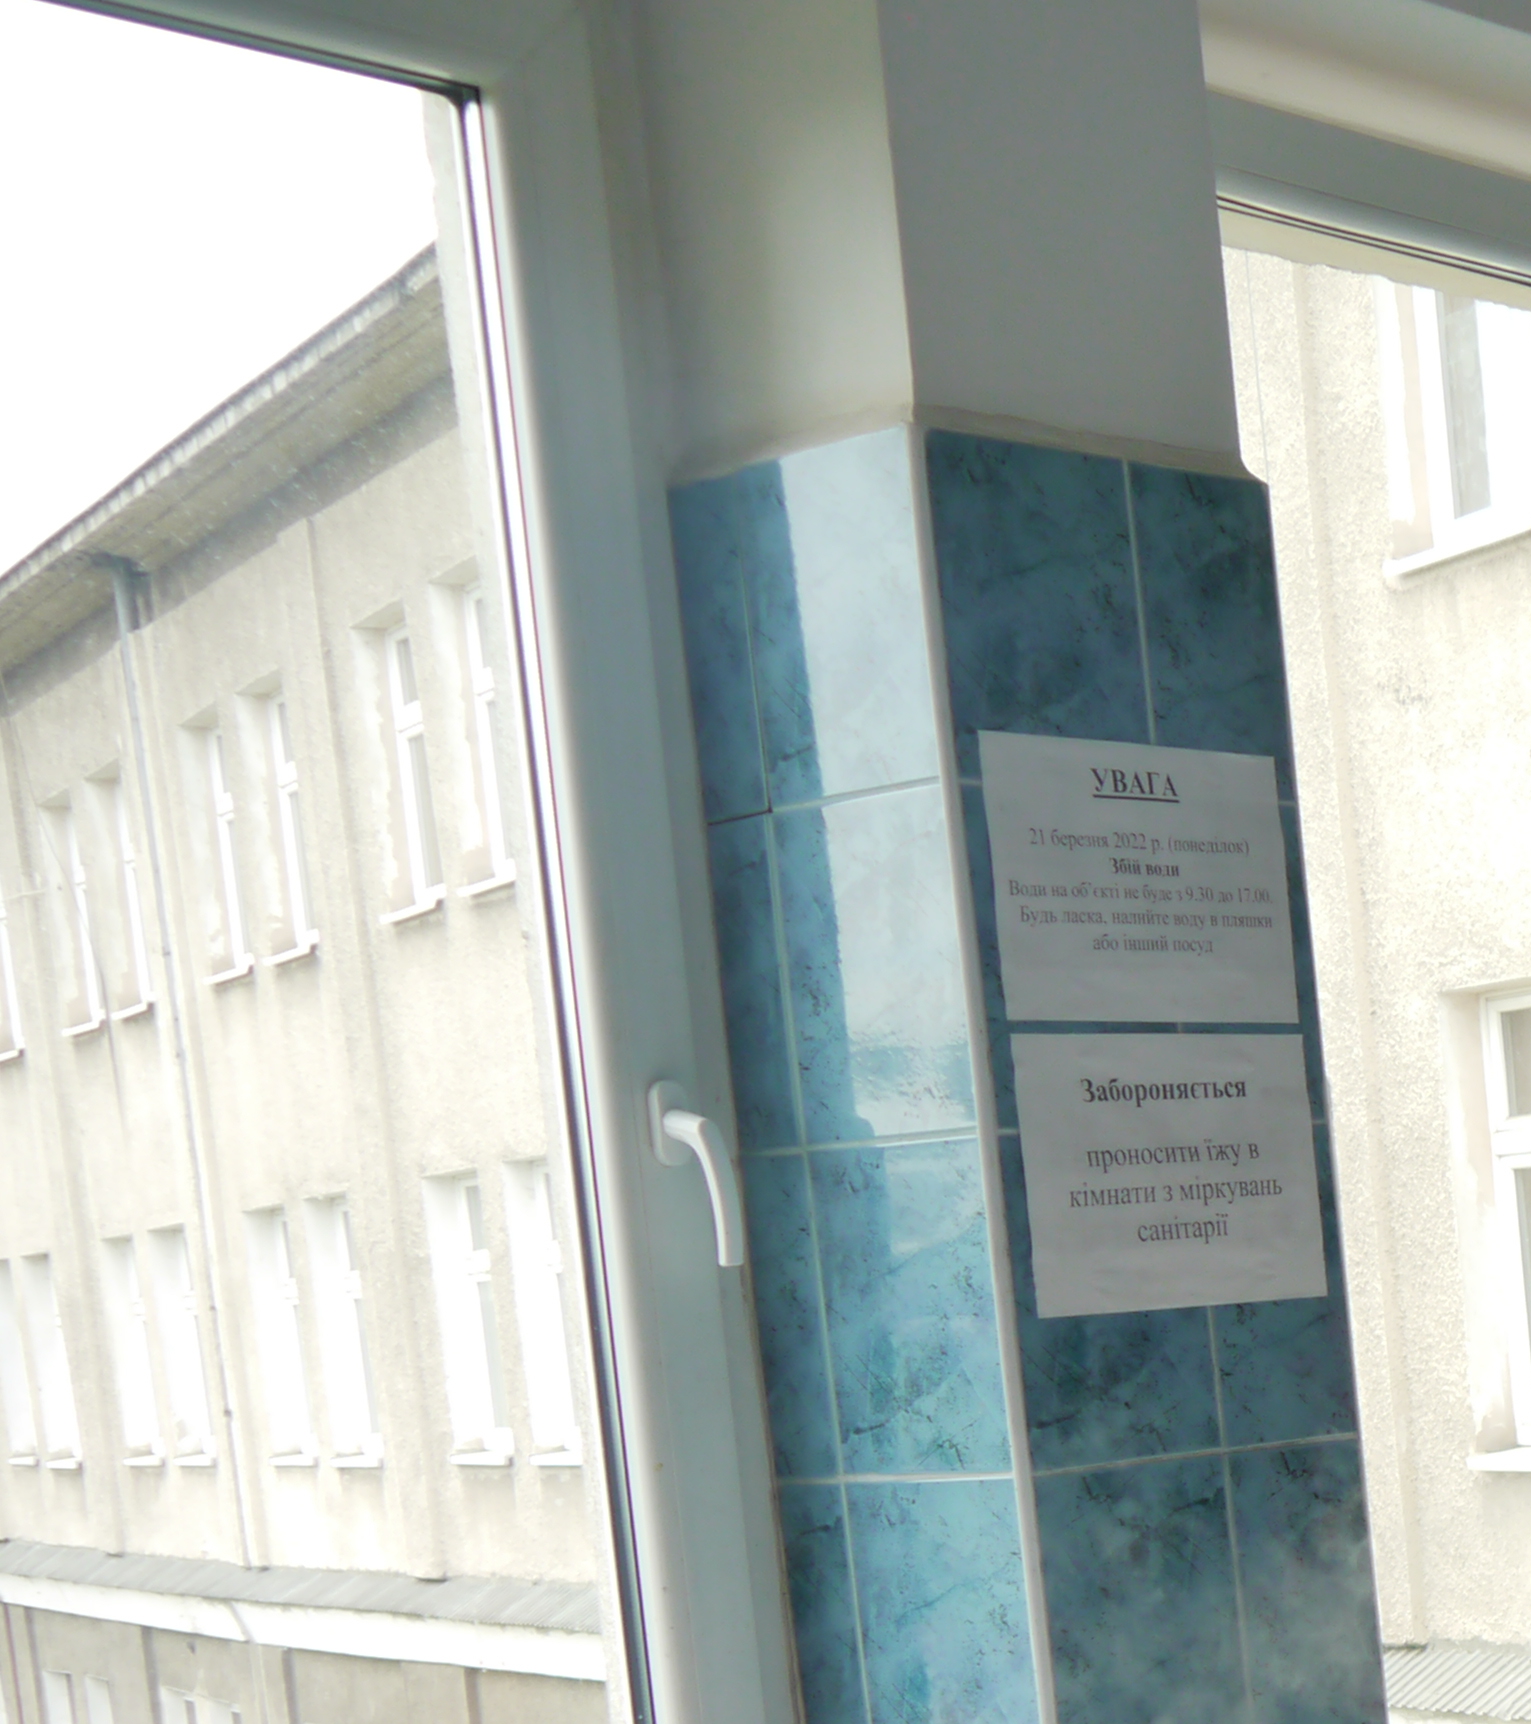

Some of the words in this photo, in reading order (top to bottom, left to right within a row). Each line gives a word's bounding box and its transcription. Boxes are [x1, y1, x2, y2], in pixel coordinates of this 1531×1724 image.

[1090, 767, 1179, 798] УВАГА
[1029, 828, 1046, 846] 21
[1050, 829, 1109, 853] березня
[1112, 832, 1148, 850] 2022
[1151, 837, 1165, 855] р.
[1167, 837, 1251, 856] (понеділок)
[1109, 857, 1142, 877] Збій
[1145, 863, 1180, 877] води
[1008, 880, 1047, 898] Води
[1051, 885, 1068, 898] на
[1123, 887, 1140, 899] не
[1142, 883, 1173, 903] буде
[1185, 886, 1214, 902] 9.30
[1217, 890, 1234, 904] до
[1237, 887, 1273, 904] 17.00.
[1020, 905, 1058, 927] Будь
[1062, 911, 1107, 926] ласка,
[1111, 911, 1169, 927] налийте
[1173, 914, 1205, 932] воду
[1210, 915, 1218, 927] в
[1222, 915, 1273, 928] пляшки
[1092, 934, 1119, 952] або
[1123, 935, 1169, 953] інший
[1172, 939, 1213, 956] посуд
[1080, 1077, 1247, 1107] Забороняється
[1087, 1145, 1201, 1173] проносити
[1204, 1138, 1242, 1167] їжу
[1248, 1142, 1260, 1159] в
[1069, 1181, 1156, 1208] кімнати
[1163, 1182, 1173, 1202] з
[1179, 1176, 1283, 1206] міркувань
[1137, 1213, 1229, 1244] санітарії
